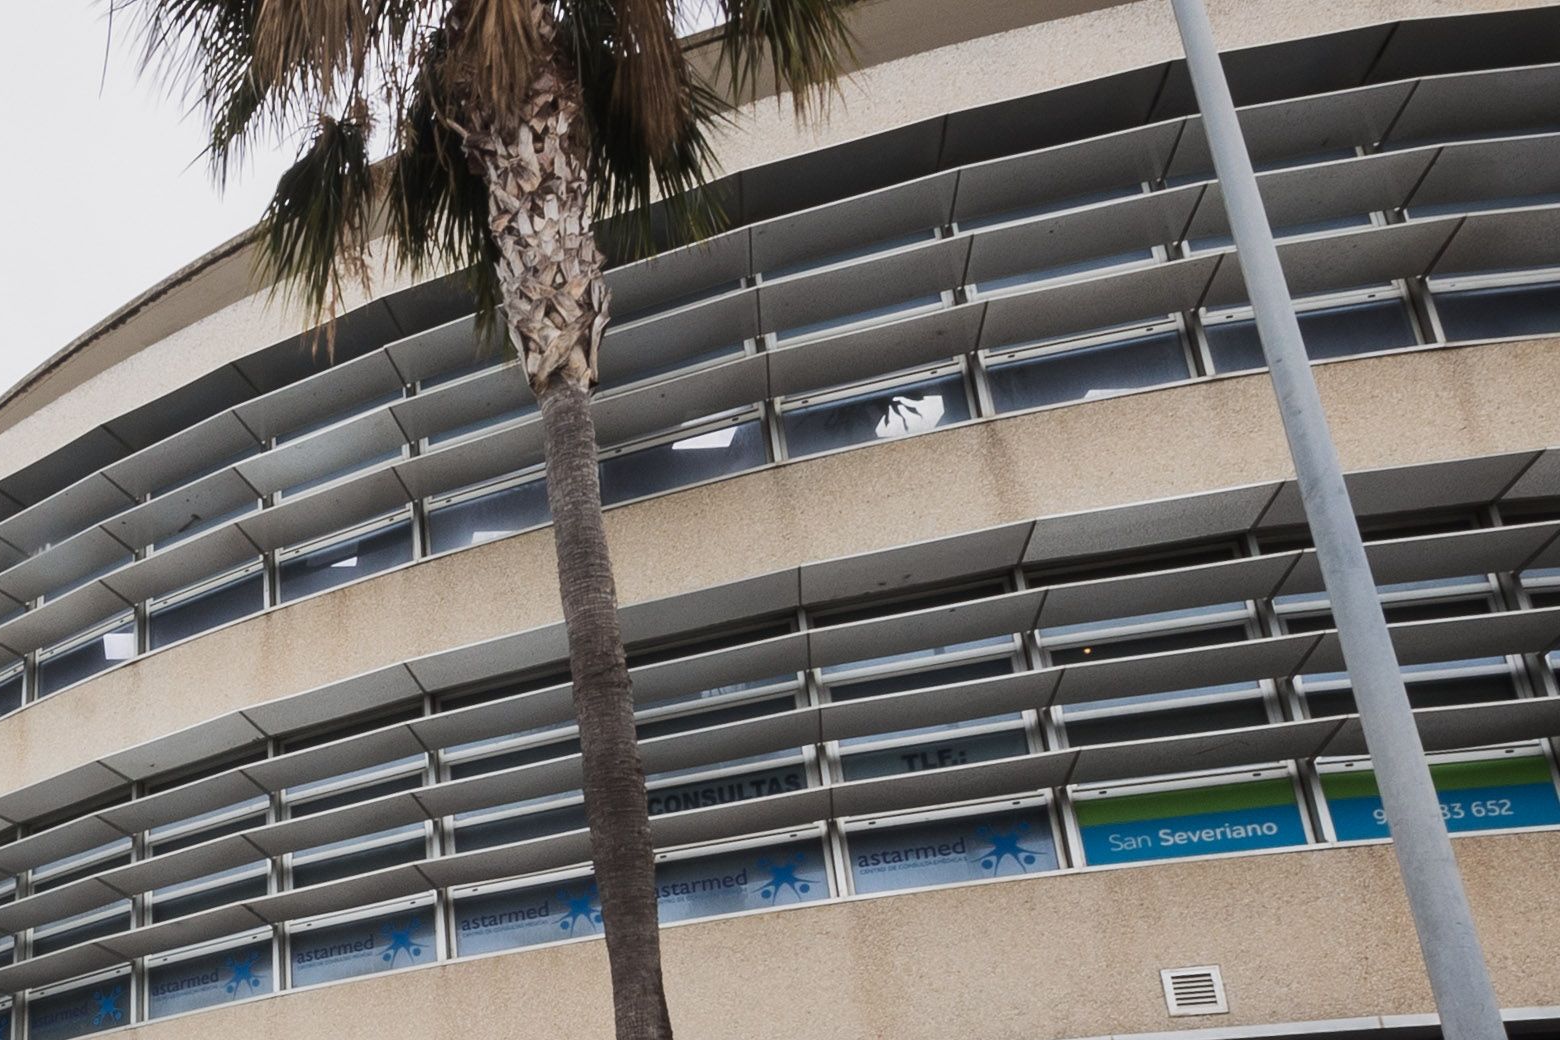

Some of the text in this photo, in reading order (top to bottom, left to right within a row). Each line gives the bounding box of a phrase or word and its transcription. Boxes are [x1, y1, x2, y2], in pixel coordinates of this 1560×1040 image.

[648, 773, 801, 815] CONSULTAS
[1439, 799, 1514, 820] 83 652
[1108, 821, 1278, 852] San Severiano
[857, 837, 966, 868] astarmed
[461, 900, 549, 931] astarmed
[296, 934, 375, 964] astarmed
[152, 969, 219, 997] astarmed
